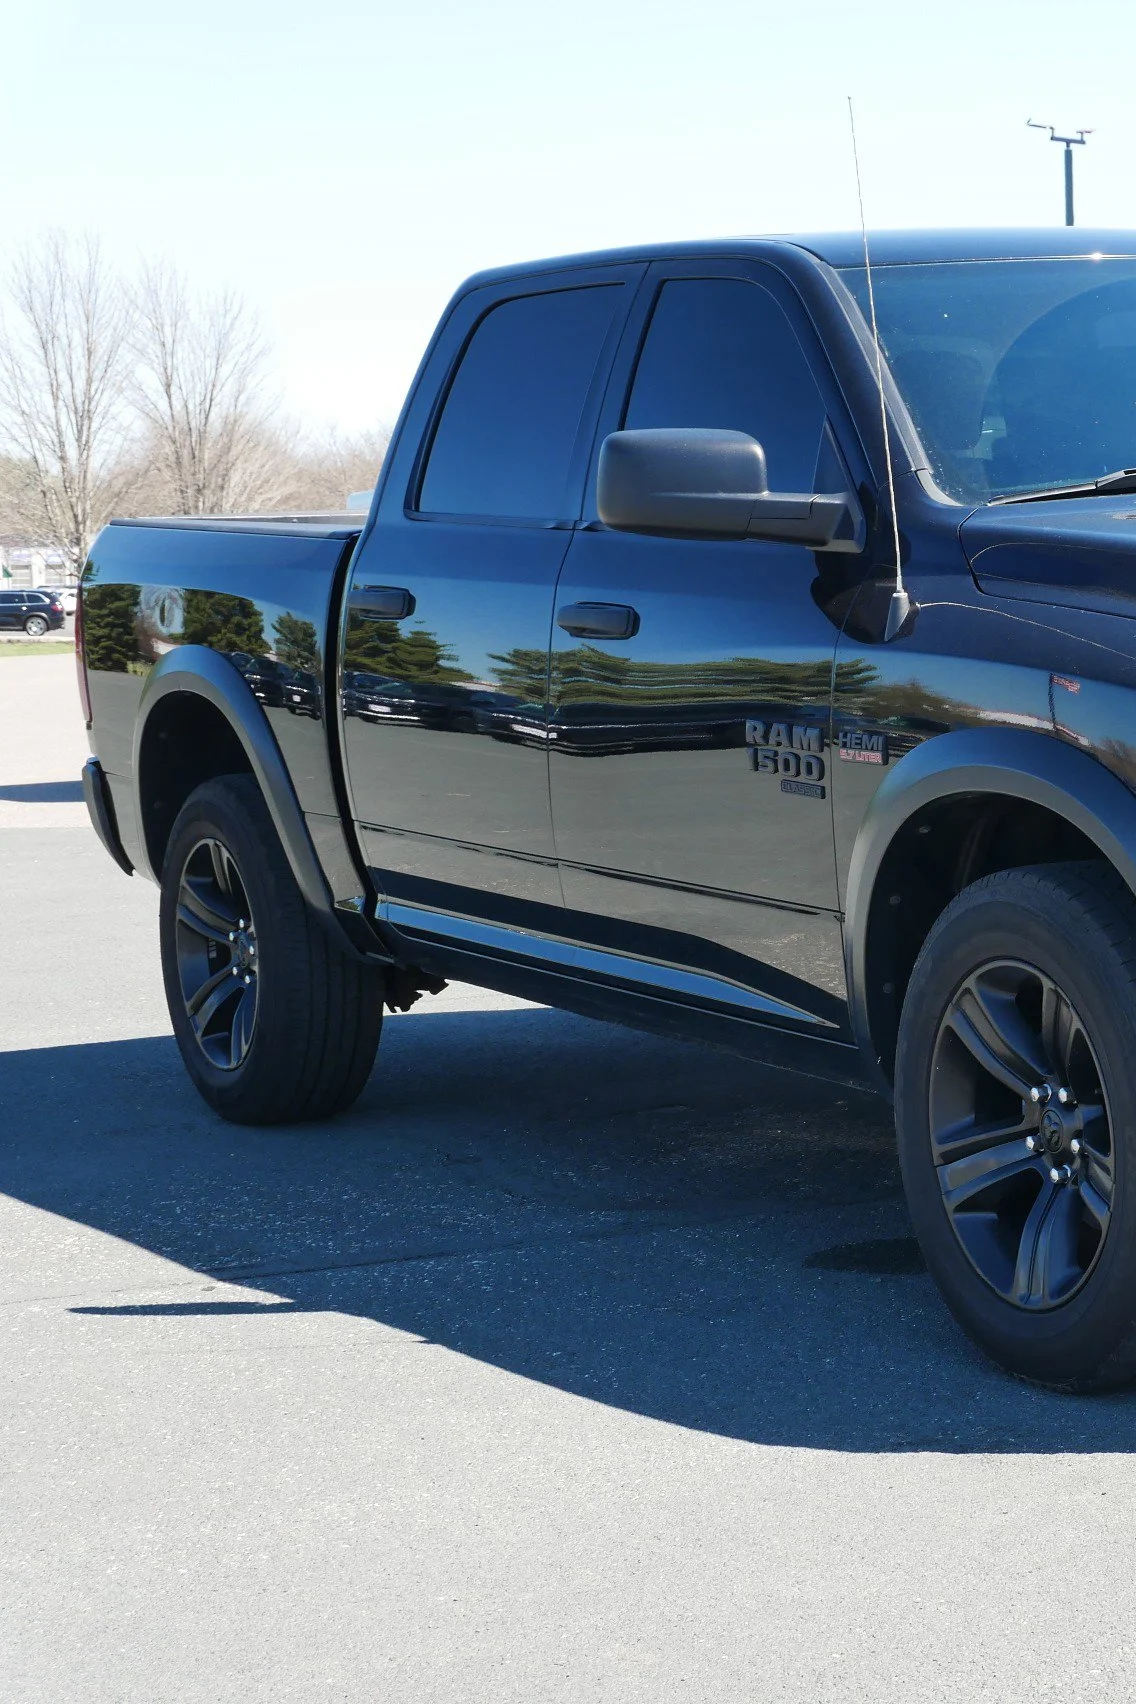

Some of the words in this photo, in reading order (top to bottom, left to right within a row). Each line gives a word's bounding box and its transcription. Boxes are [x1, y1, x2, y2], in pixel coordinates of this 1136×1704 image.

[745, 719, 824, 753] RAM
[838, 731, 884, 751] HEMI
[747, 747, 825, 781] 1500
[839, 749, 854, 760] 5.7
[855, 750, 882, 763] LITER
[781, 780, 822, 799] CLASSIC
